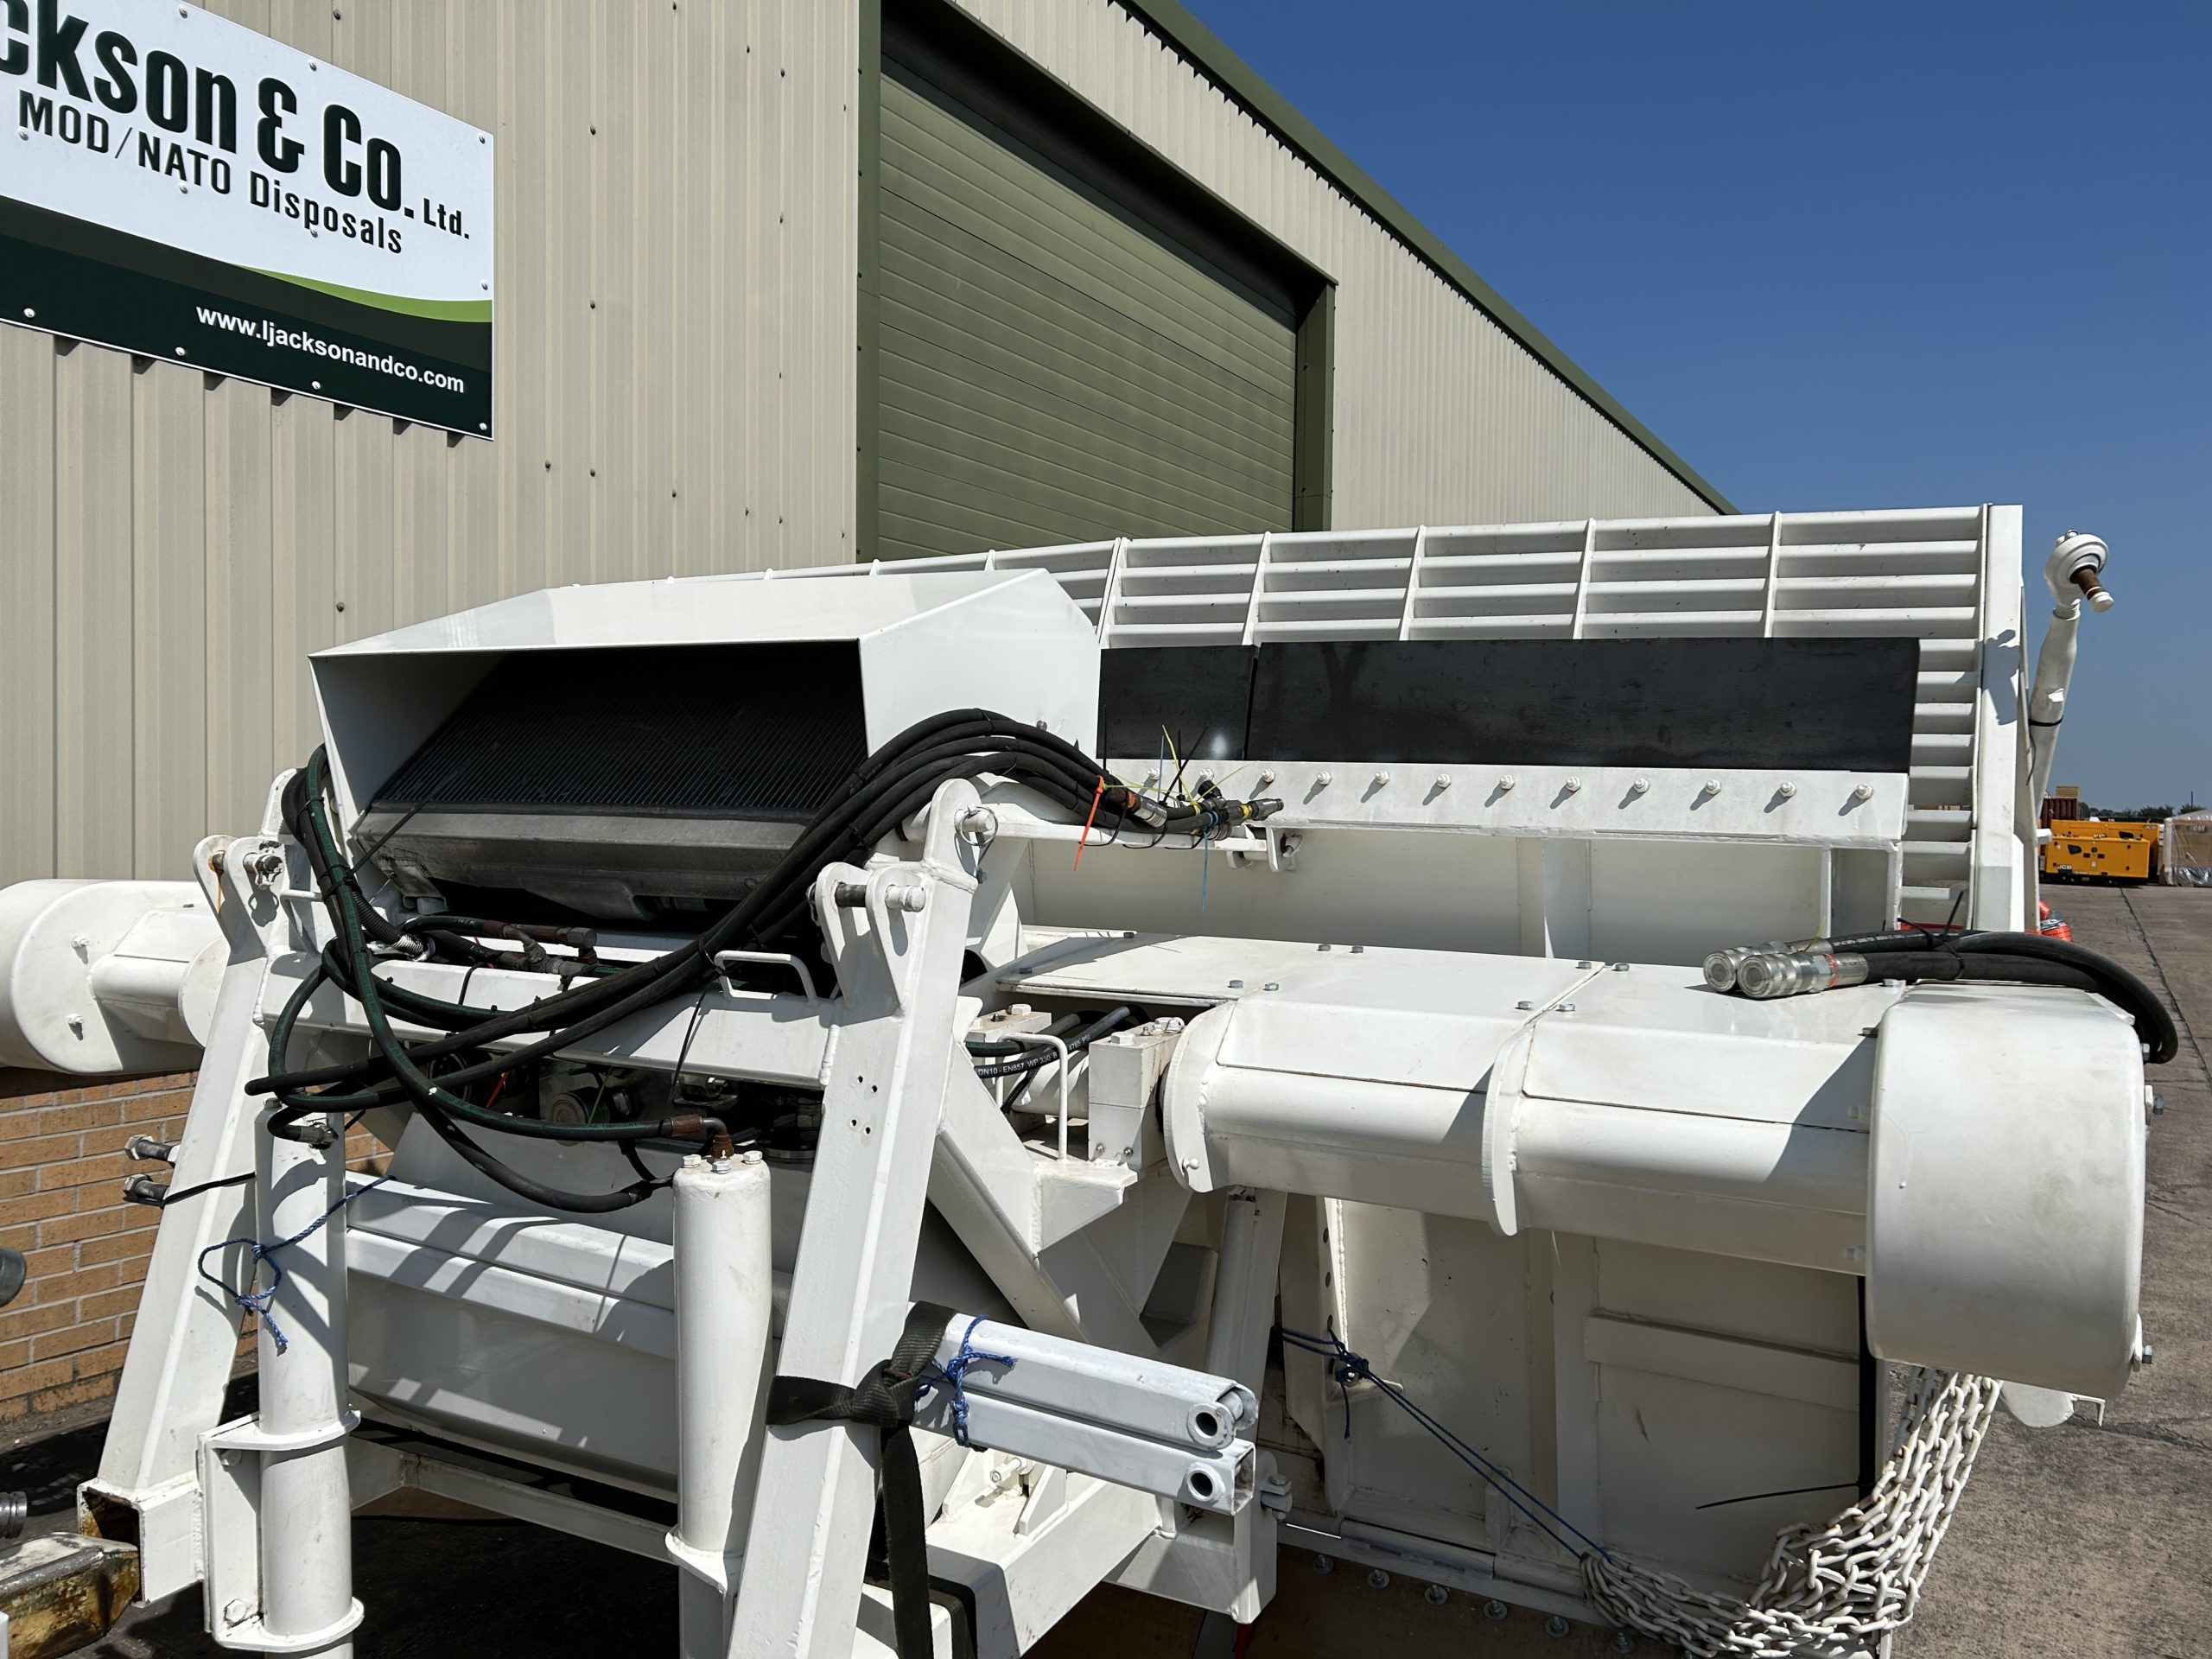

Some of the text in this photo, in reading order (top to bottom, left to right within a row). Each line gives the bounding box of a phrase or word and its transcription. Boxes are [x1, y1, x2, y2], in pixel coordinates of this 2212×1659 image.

[19, 89, 402, 254] MOD/NATO Disposals
[257, 78, 305, 174] &
[323, 105, 415, 219] Co.
[423, 198, 470, 239] Ltd.
[196, 306, 464, 393] www.ljacksonandco.com
[1002, 1062, 1025, 1073] EN857
[1027, 1058, 1039, 1067] WP
